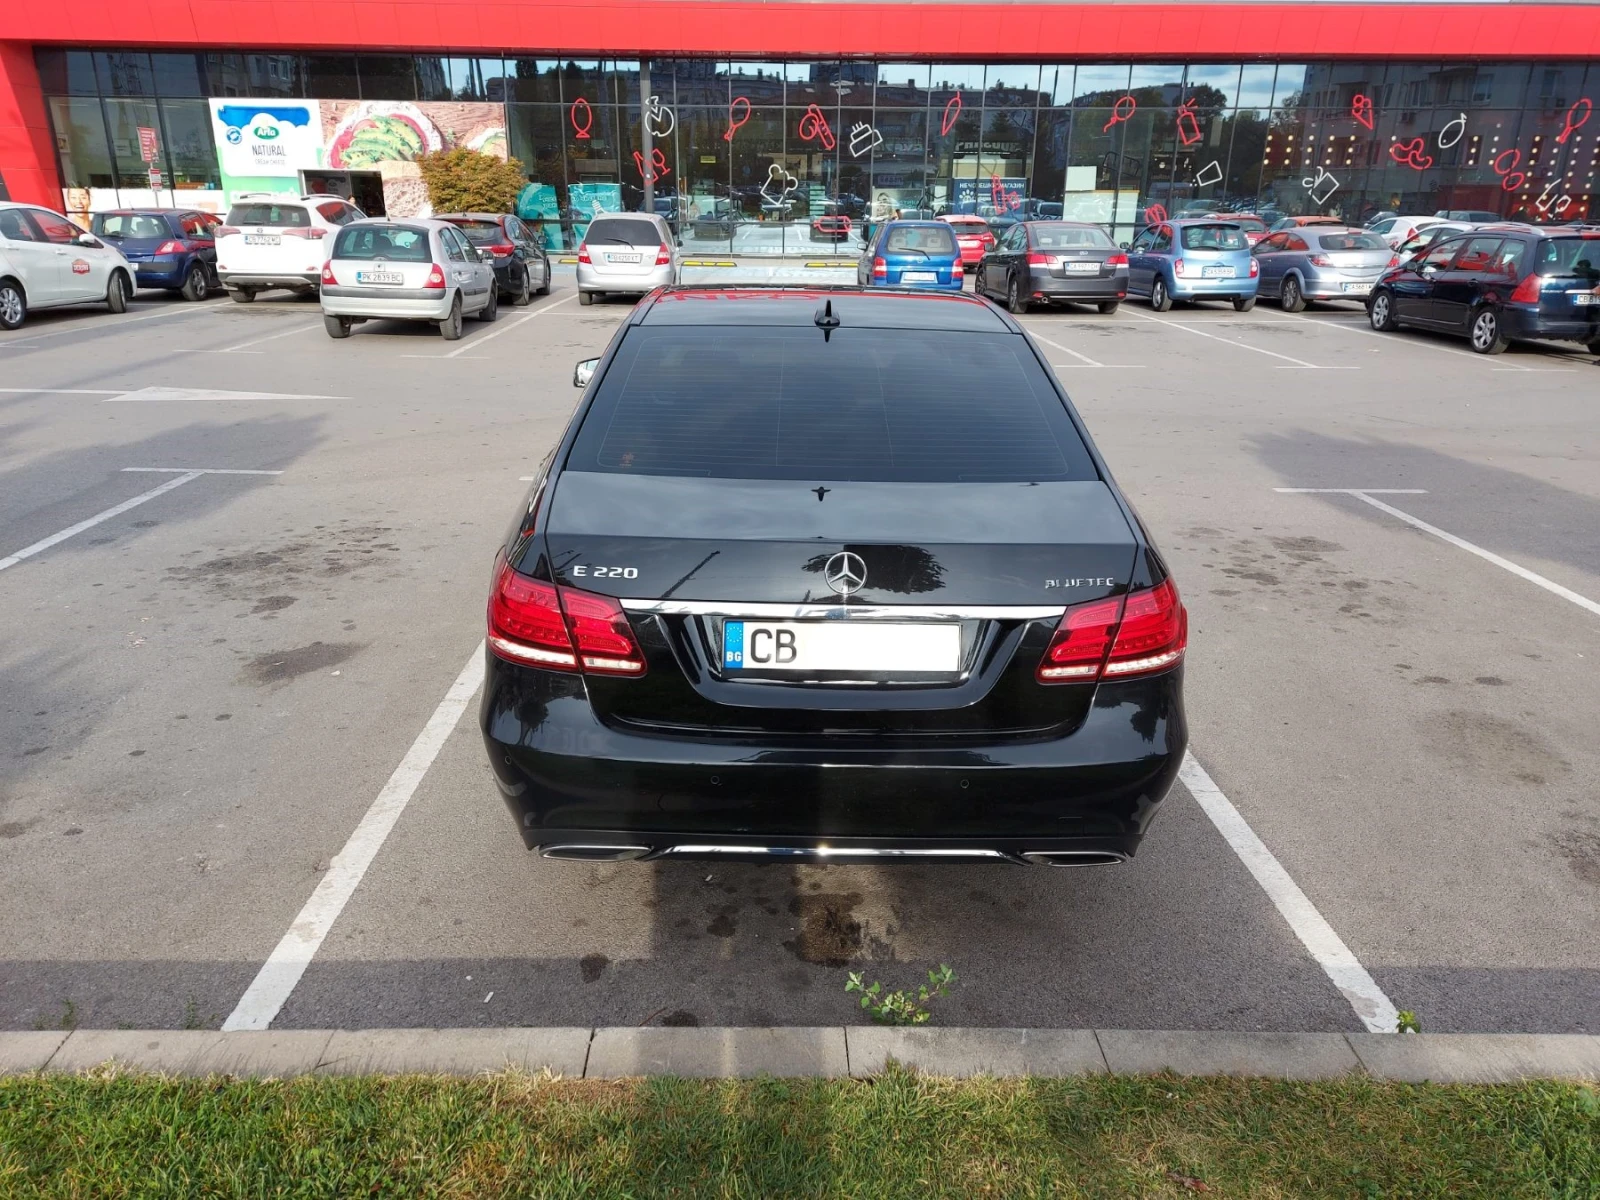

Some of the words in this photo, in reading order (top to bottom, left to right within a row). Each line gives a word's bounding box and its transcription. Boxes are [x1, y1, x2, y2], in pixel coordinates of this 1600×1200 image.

[257, 127, 276, 136] Arla
[252, 145, 287, 156] NATURAL
[373, 274, 390, 282] 2839
[391, 274, 401, 282] BC
[573, 565, 588, 577] E
[593, 566, 638, 579] 220
[726, 651, 742, 662] BG
[750, 628, 797, 663] CB
